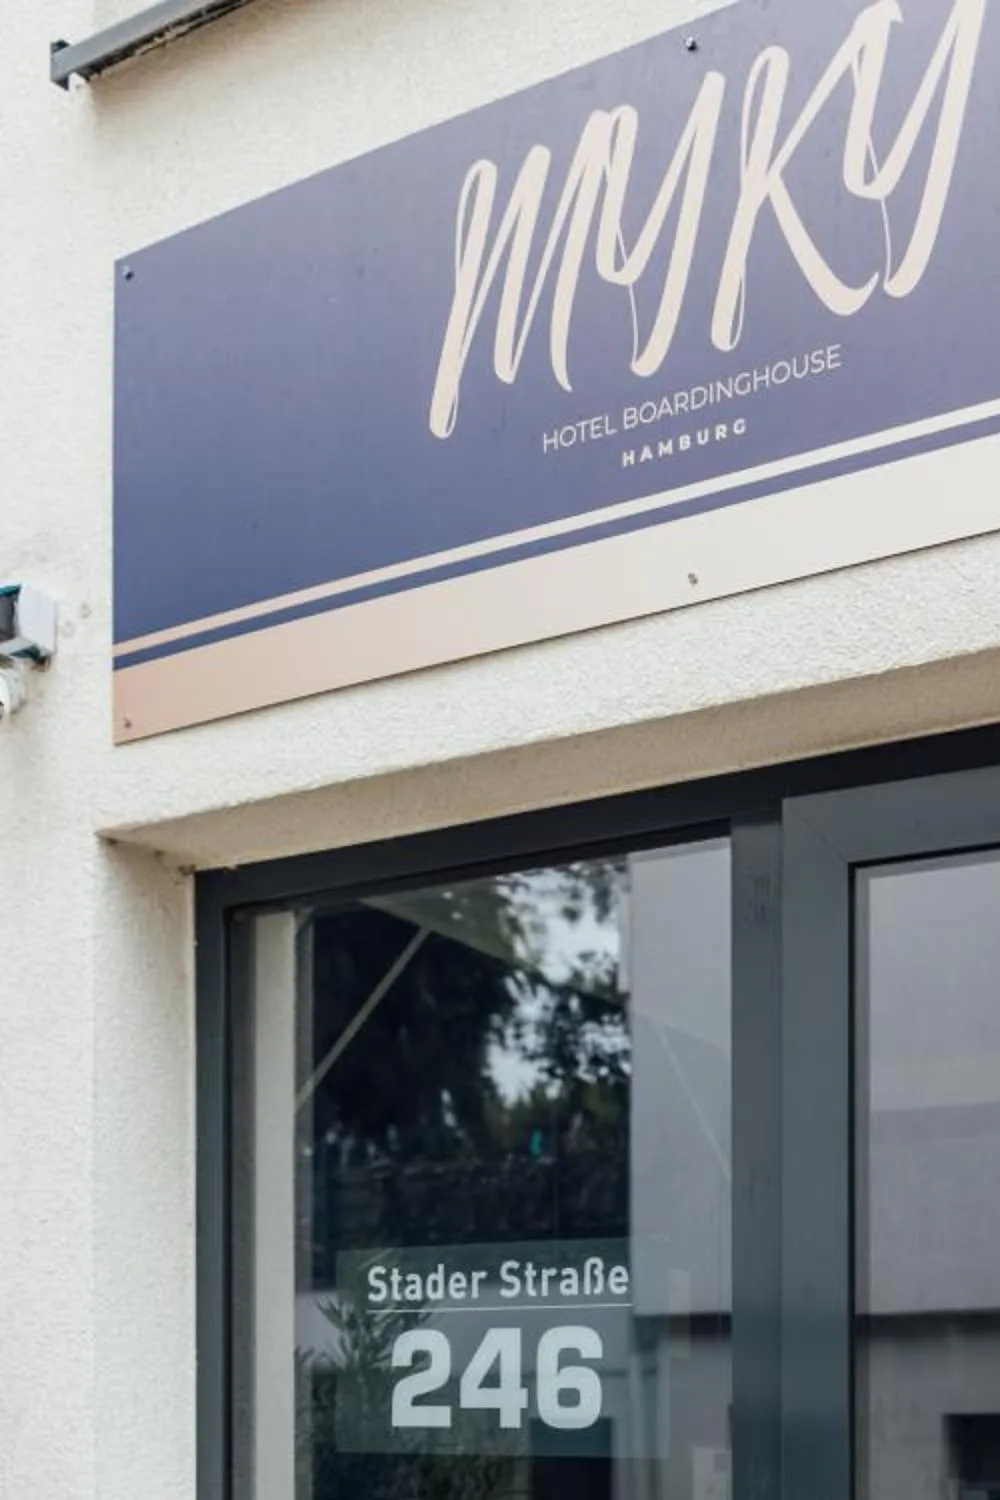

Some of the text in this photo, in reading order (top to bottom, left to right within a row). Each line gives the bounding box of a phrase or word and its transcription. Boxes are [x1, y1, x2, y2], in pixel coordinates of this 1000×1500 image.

[543, 344, 843, 454] HOTEL BOARDINGHOUSE
[621, 418, 748, 467] HAMBURG
[367, 1256, 629, 1302] Stader Straße
[391, 1325, 603, 1430] 246
